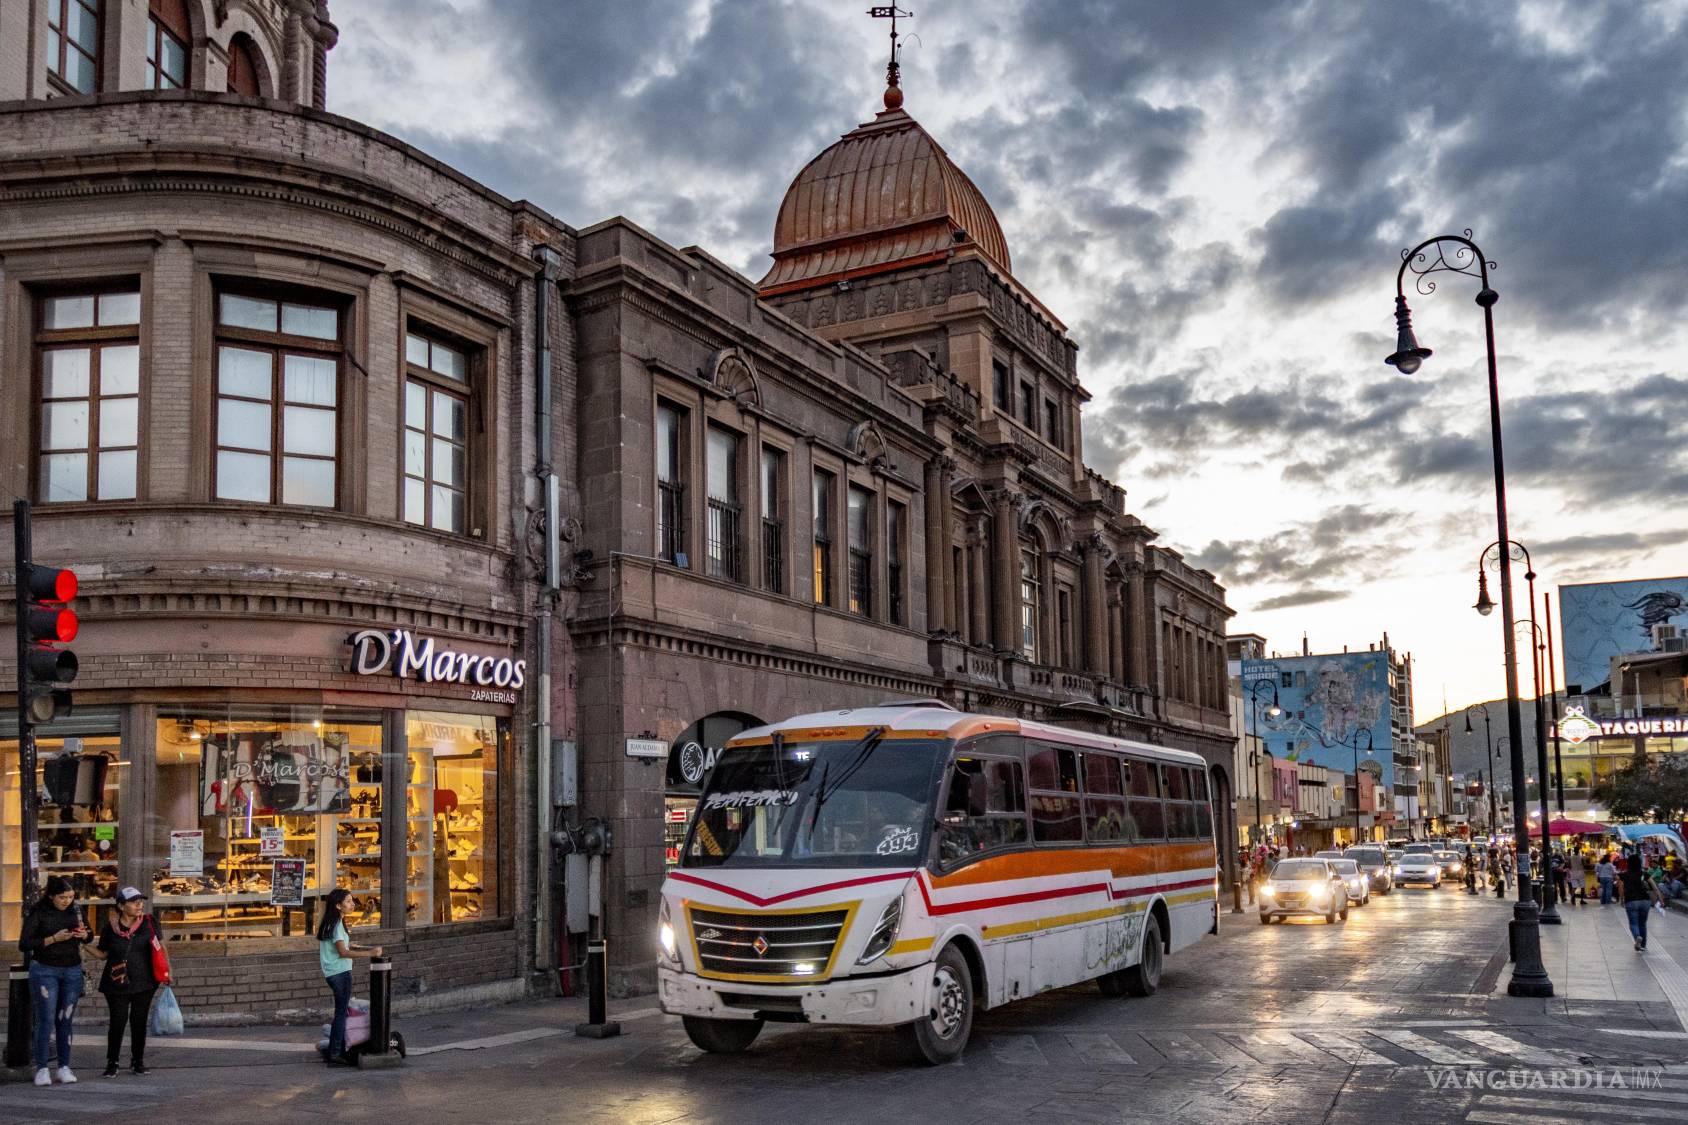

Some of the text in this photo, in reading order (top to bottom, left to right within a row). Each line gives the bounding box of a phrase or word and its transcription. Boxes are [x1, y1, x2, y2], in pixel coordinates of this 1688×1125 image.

[354, 629, 526, 689] D'Marcos
[1244, 665, 1278, 673] HOTEL
[233, 760, 339, 777] D'Marcos
[876, 832, 919, 856] 494
